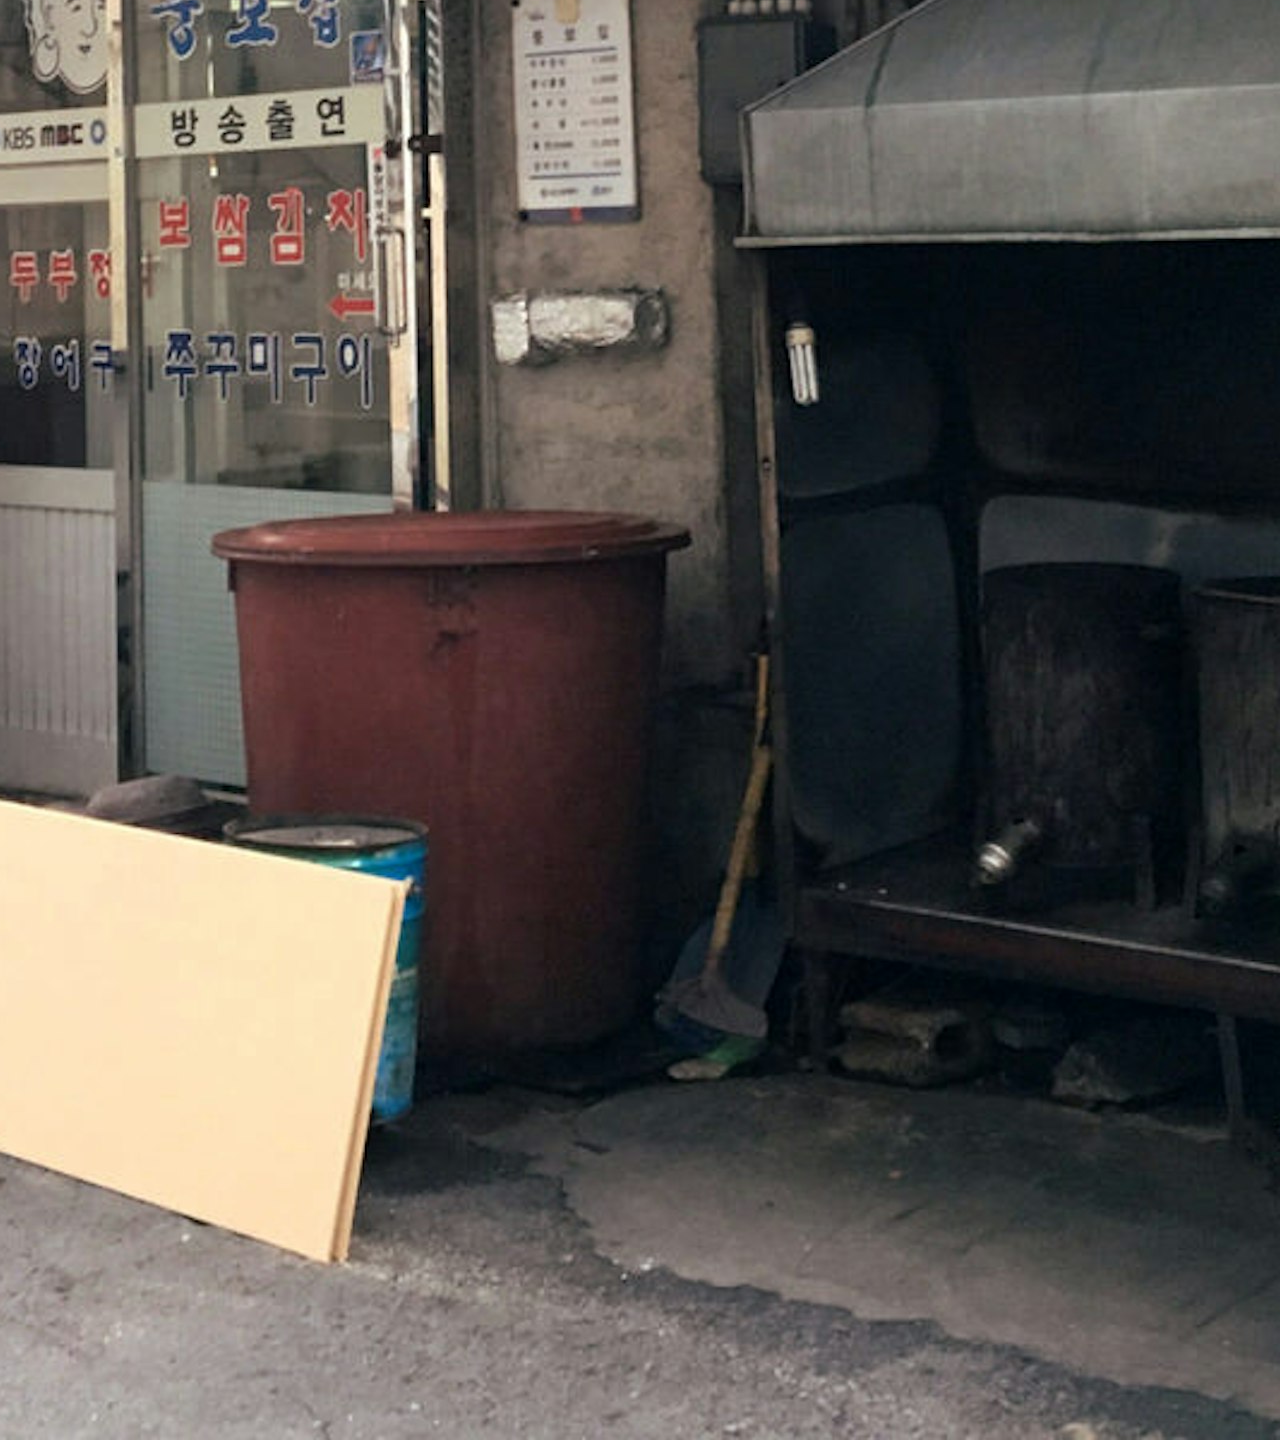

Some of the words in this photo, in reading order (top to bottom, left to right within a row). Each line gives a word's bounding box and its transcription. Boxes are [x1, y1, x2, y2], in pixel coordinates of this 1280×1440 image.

[2, 126, 35, 149] KBS
[170, 95, 346, 148] 방송출연
[158, 188, 368, 265] 보쌈김치
